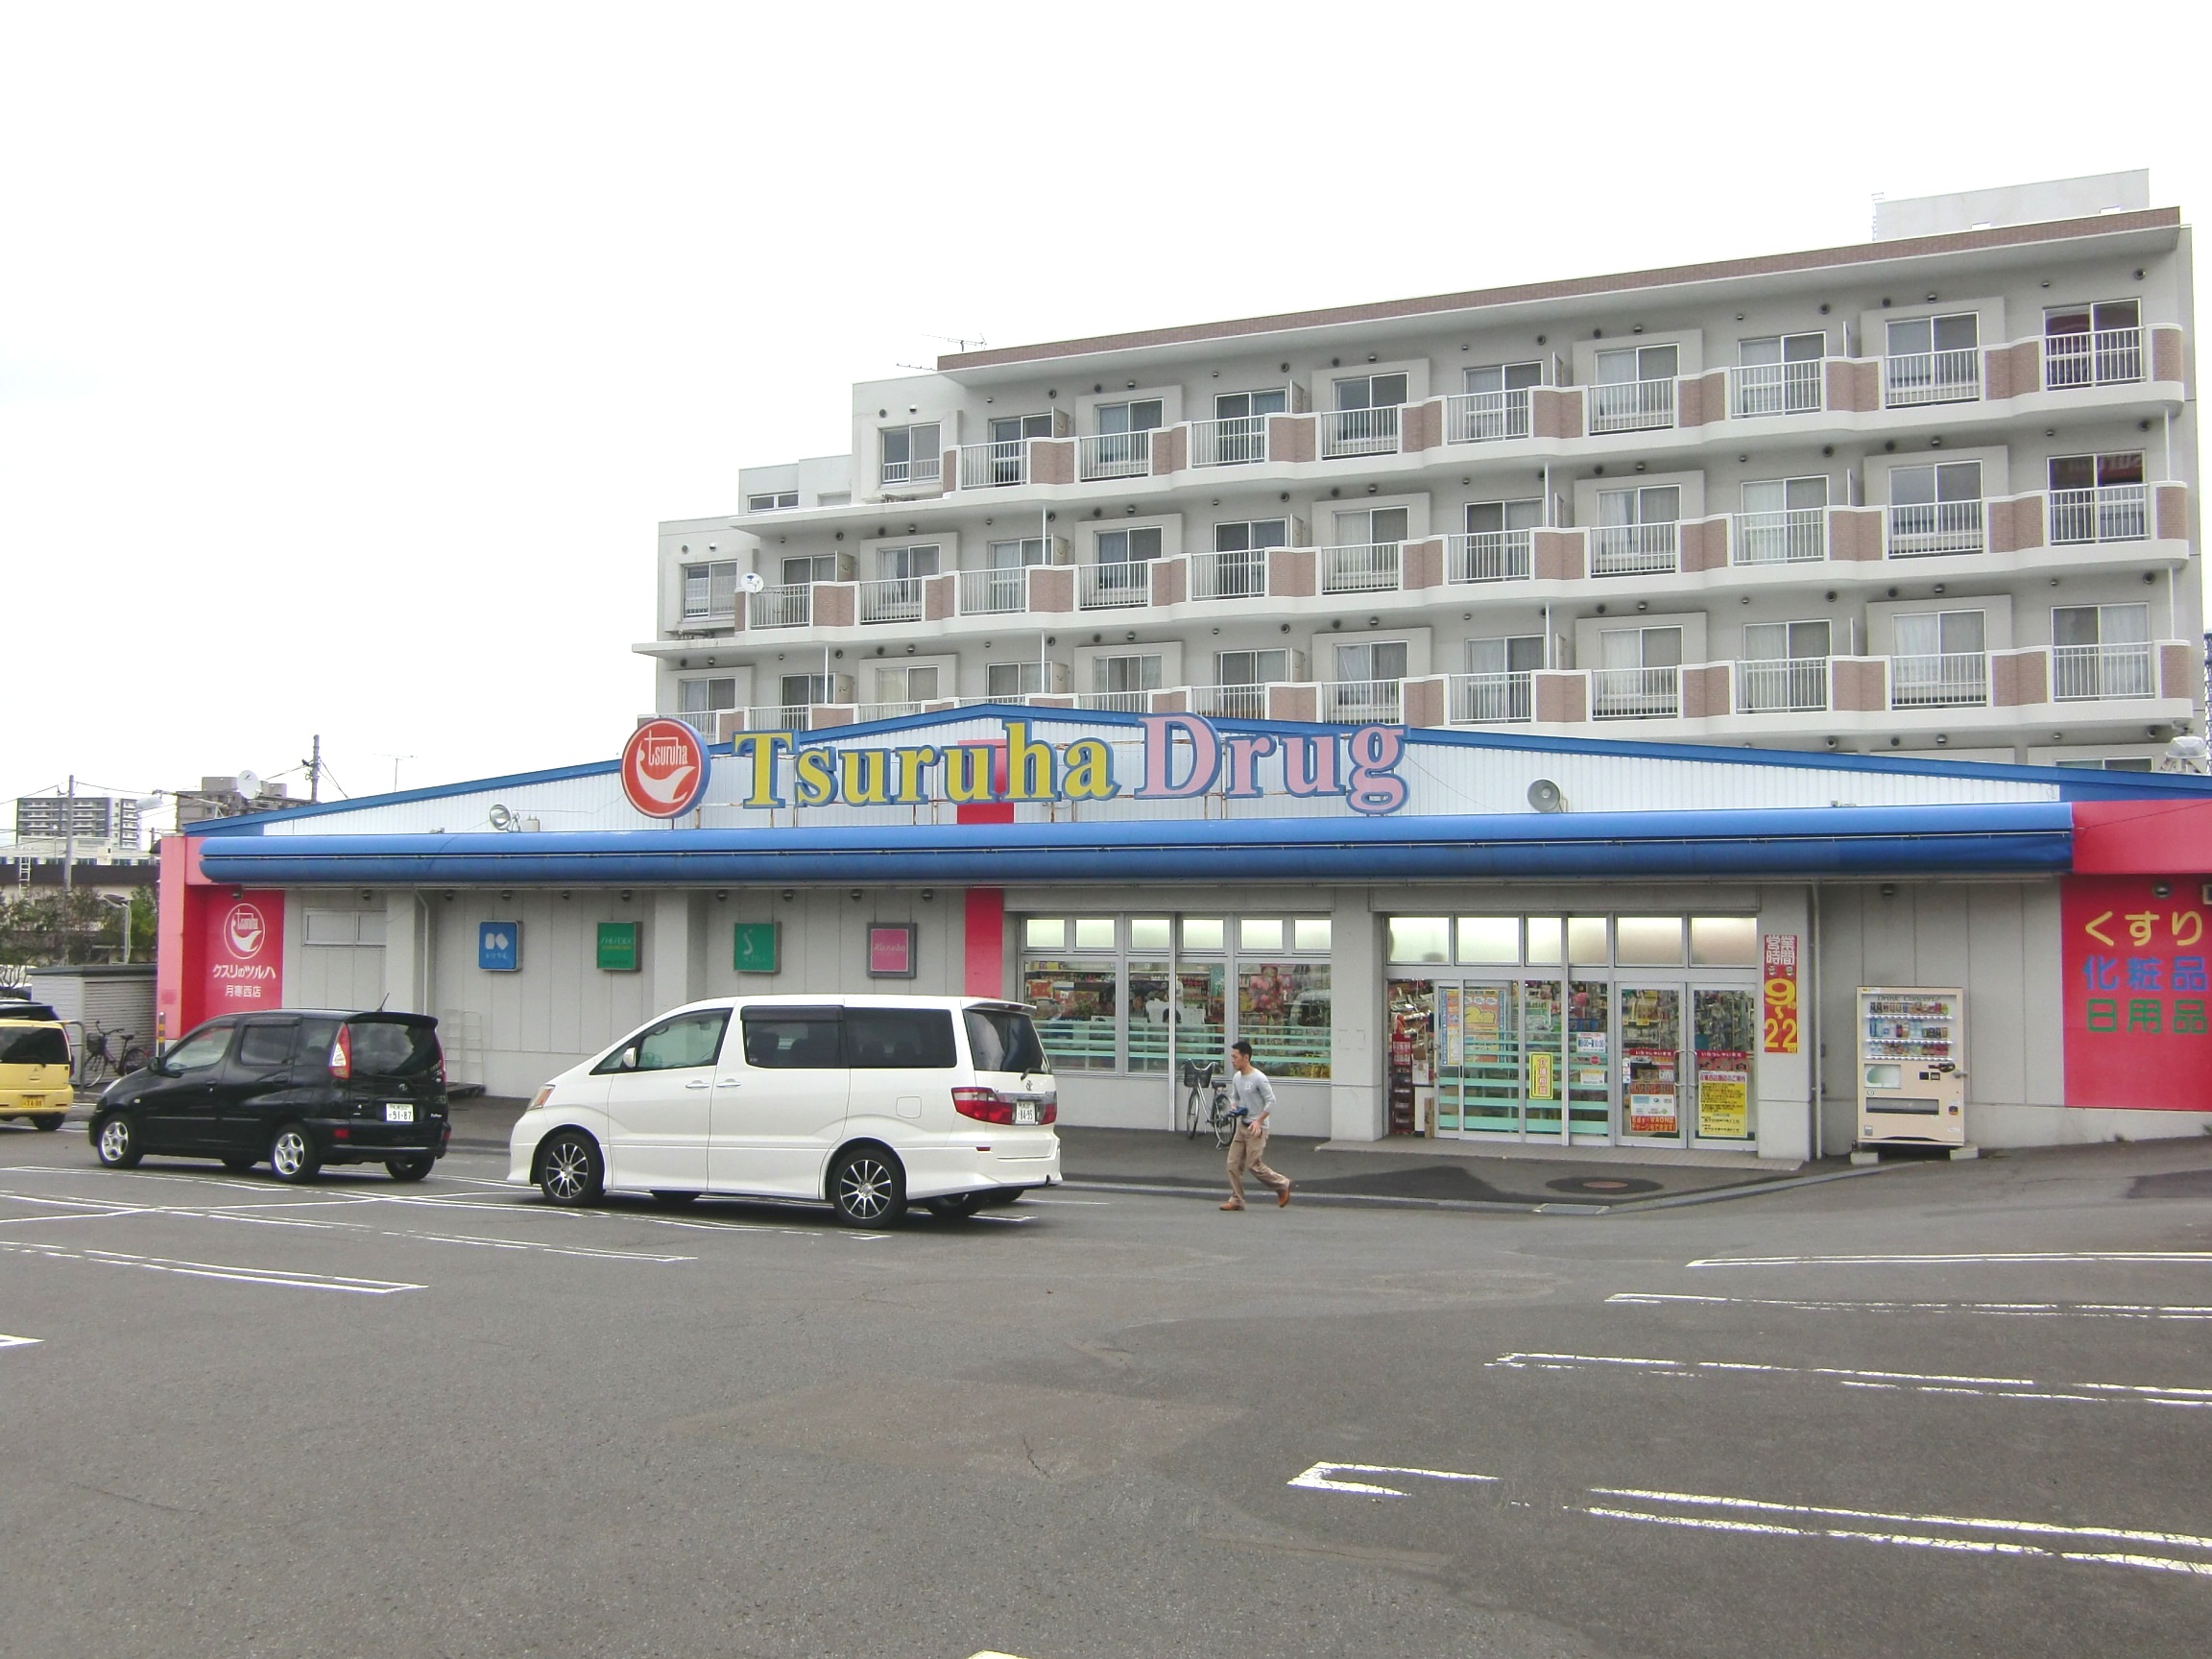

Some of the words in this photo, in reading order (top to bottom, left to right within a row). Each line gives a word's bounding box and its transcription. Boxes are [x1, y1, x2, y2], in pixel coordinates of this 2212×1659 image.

[643, 729, 688, 766] tsuruha
[733, 719, 1120, 809] Tsuruha
[1135, 712, 1409, 815] Drug
[2084, 910, 2203, 948] くすり
[212, 963, 277, 979] クスリのツルハ
[2082, 955, 2208, 991] 化粧品
[2087, 998, 2207, 1034] 日用品
